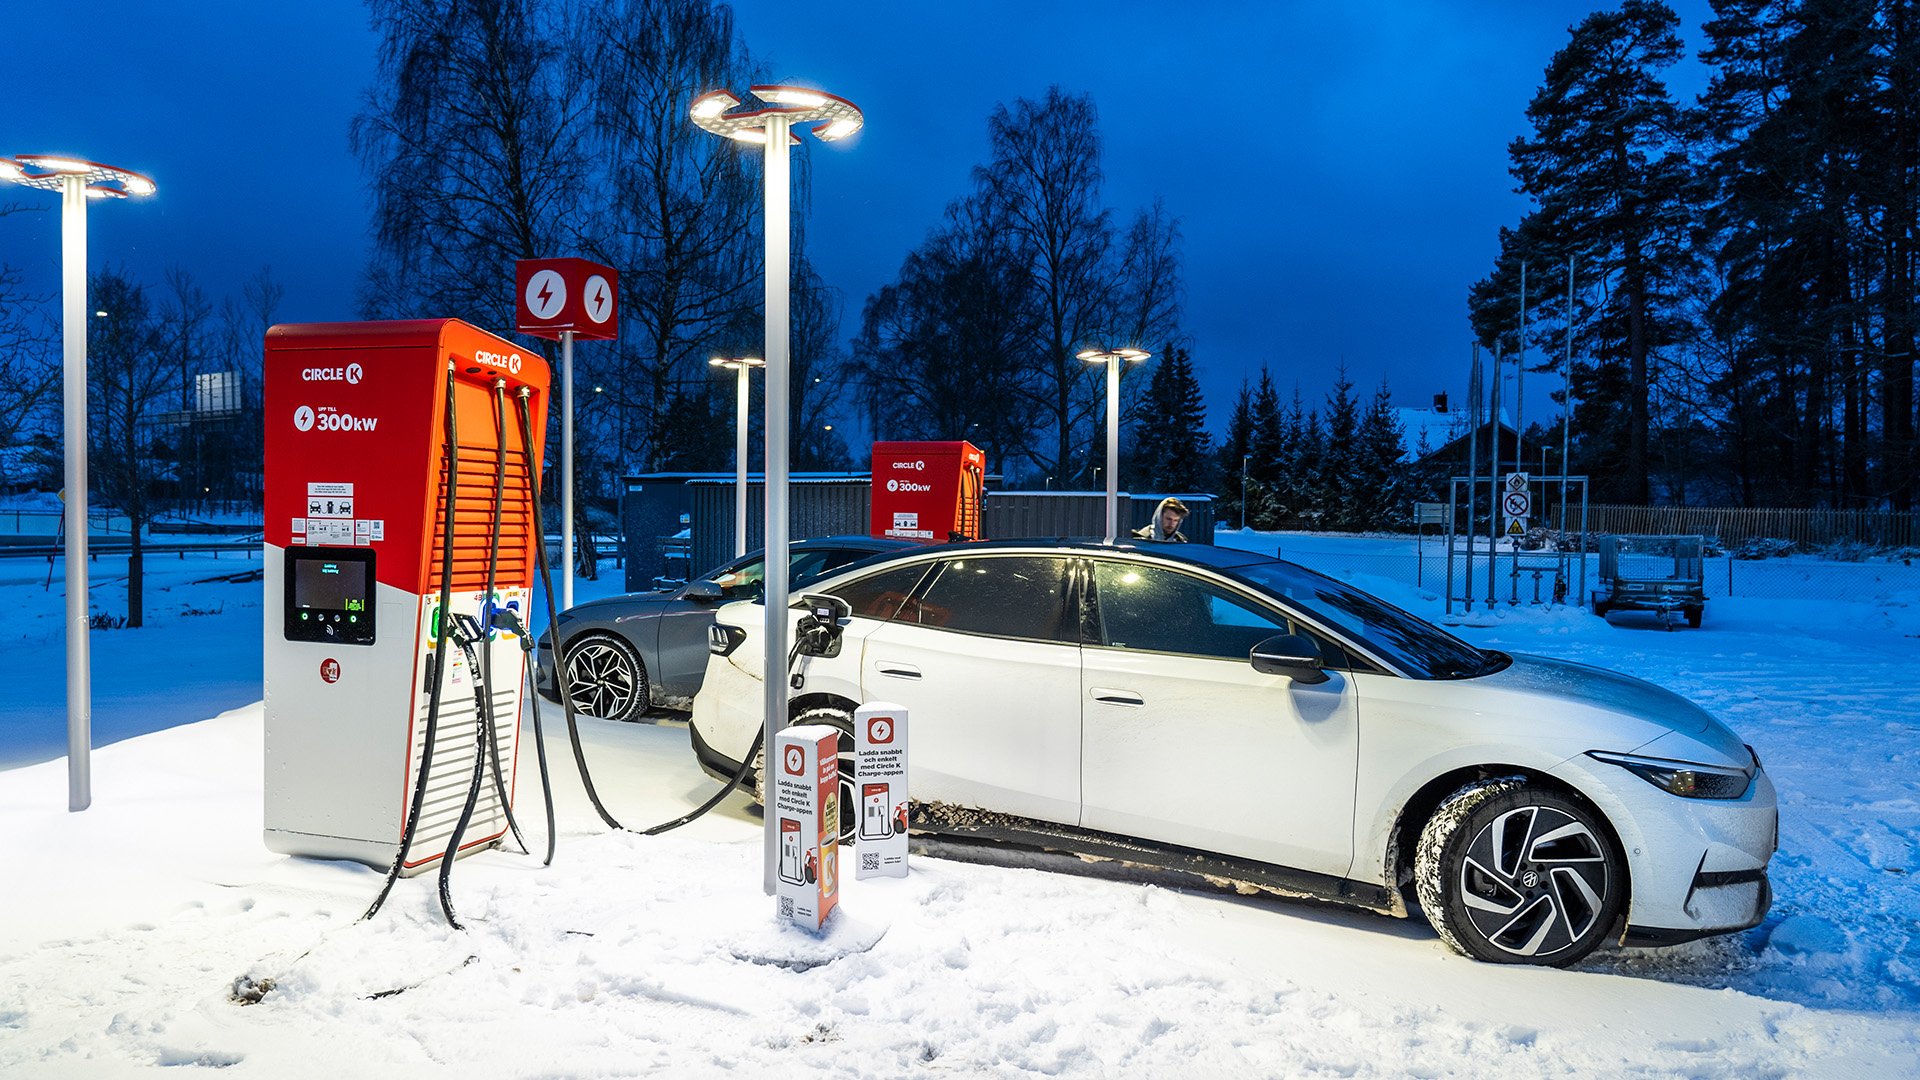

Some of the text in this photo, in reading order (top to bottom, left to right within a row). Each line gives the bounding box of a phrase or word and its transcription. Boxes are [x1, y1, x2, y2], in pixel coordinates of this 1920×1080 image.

[476, 350, 521, 374] CIRCLE K
[302, 364, 362, 384] CIRCLE K
[317, 414, 378, 432] 300kW
[916, 461, 924, 470] K
[900, 483, 931, 492] 300kW
[791, 797, 805, 806] Circle
[777, 802, 812, 815] Charge-appen
